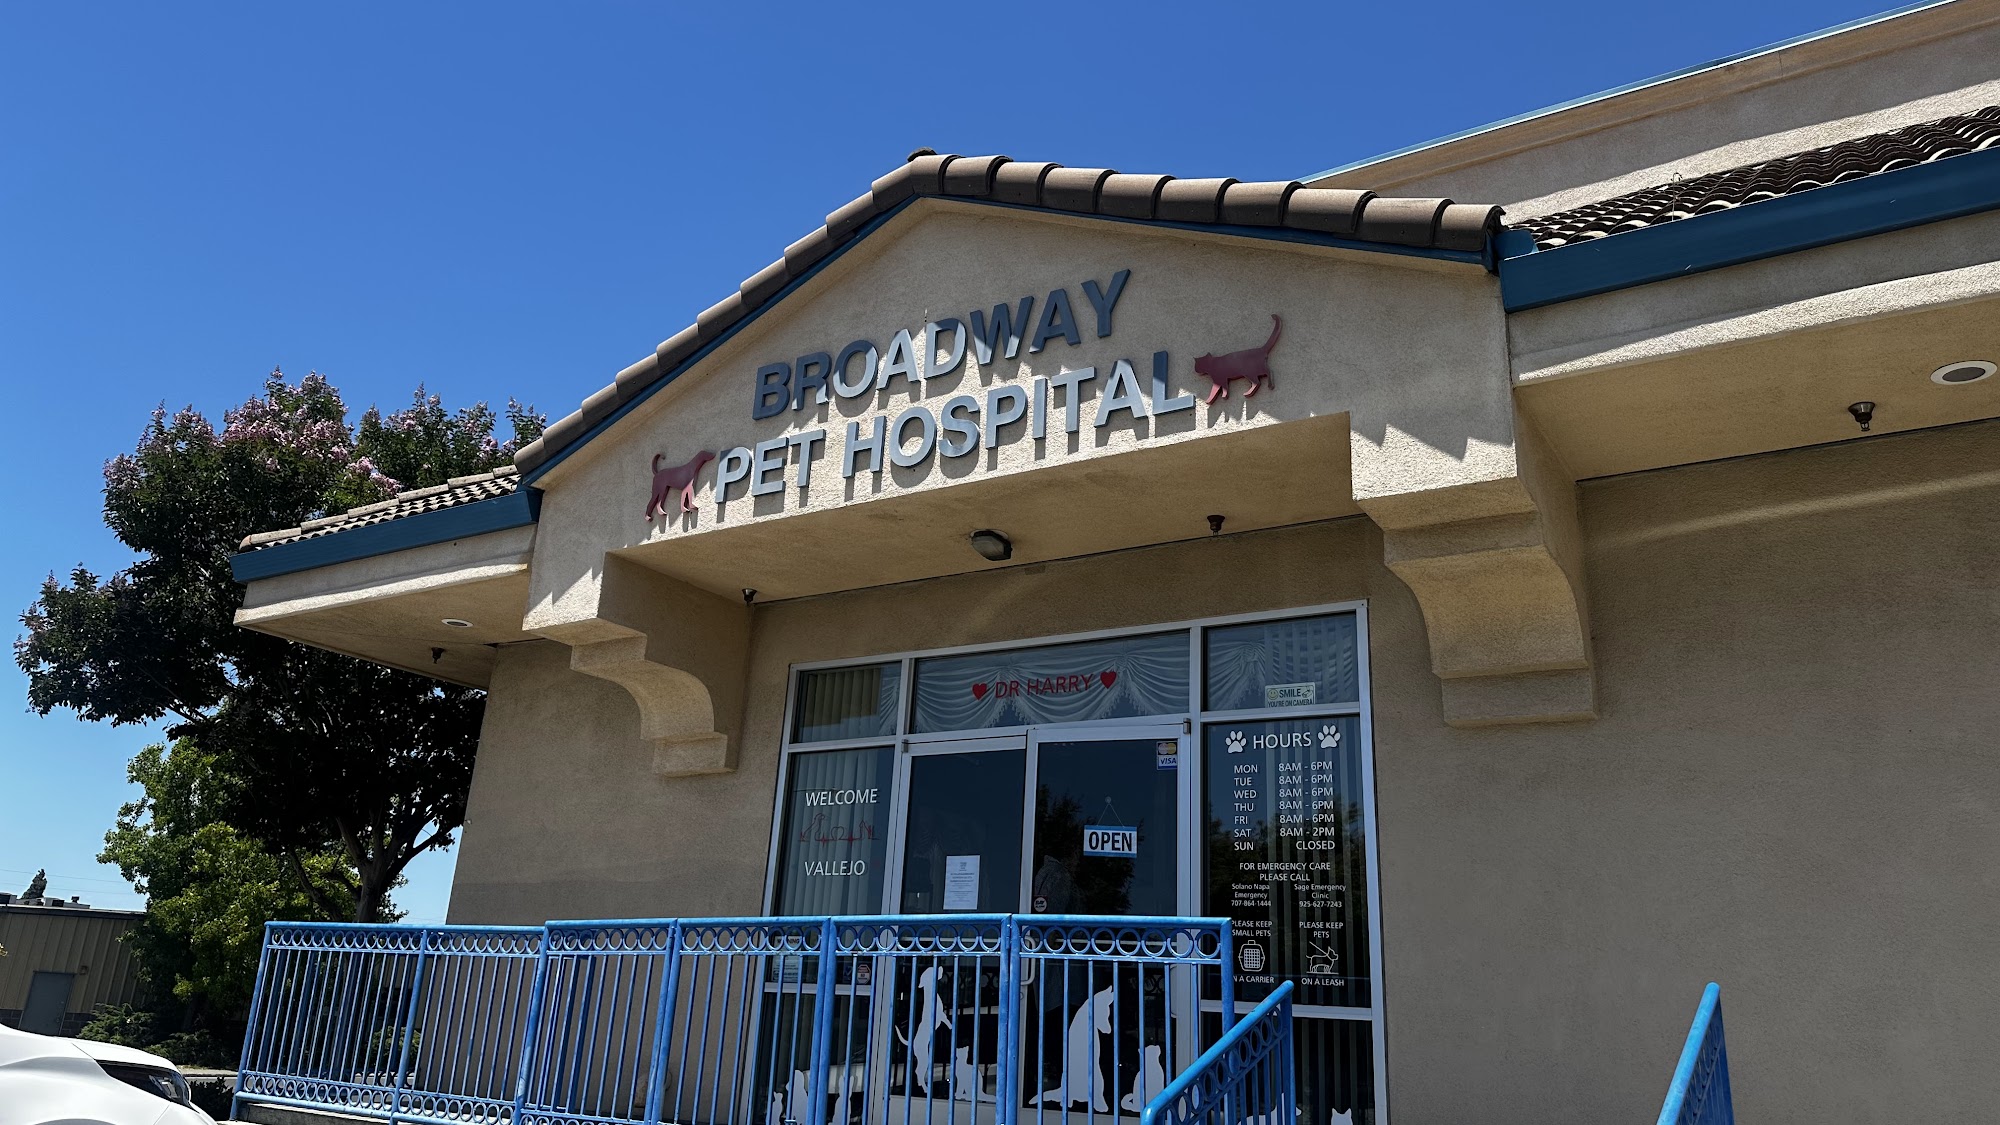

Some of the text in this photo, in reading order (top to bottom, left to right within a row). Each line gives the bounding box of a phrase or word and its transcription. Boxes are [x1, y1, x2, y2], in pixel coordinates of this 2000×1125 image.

[752, 269, 1131, 420] BROADWAY
[715, 351, 1196, 503] PET HOSPITAL
[995, 673, 1093, 698] DR HARRY
[1280, 688, 1300, 698] SMILE
[1253, 732, 1312, 749] HOURS
[1234, 764, 1258, 774] MON
[1278, 762, 1302, 772] 8AM
[1310, 761, 1332, 771] 6PM
[1234, 777, 1252, 786] TUE
[1279, 776, 1302, 785] 8AM
[1311, 774, 1333, 784] 6PM
[806, 788, 878, 806] WELCOME
[1234, 790, 1257, 799] WED
[1279, 788, 1302, 798] 8AM
[1312, 787, 1333, 797] 6PM
[1234, 803, 1254, 812] THU
[1279, 801, 1302, 810] 8AM
[1312, 801, 1334, 810] 6PM
[1234, 816, 1248, 824] FRI
[1280, 815, 1302, 823] 8AM
[1312, 814, 1334, 823] 6PM
[1234, 829, 1251, 838] SAT
[1280, 828, 1303, 837] 8AM
[1313, 827, 1334, 836] 2PM
[1088, 831, 1132, 851] OPEN
[1234, 841, 1335, 850] SUN CLOSED
[805, 860, 865, 876] VALLEJO
